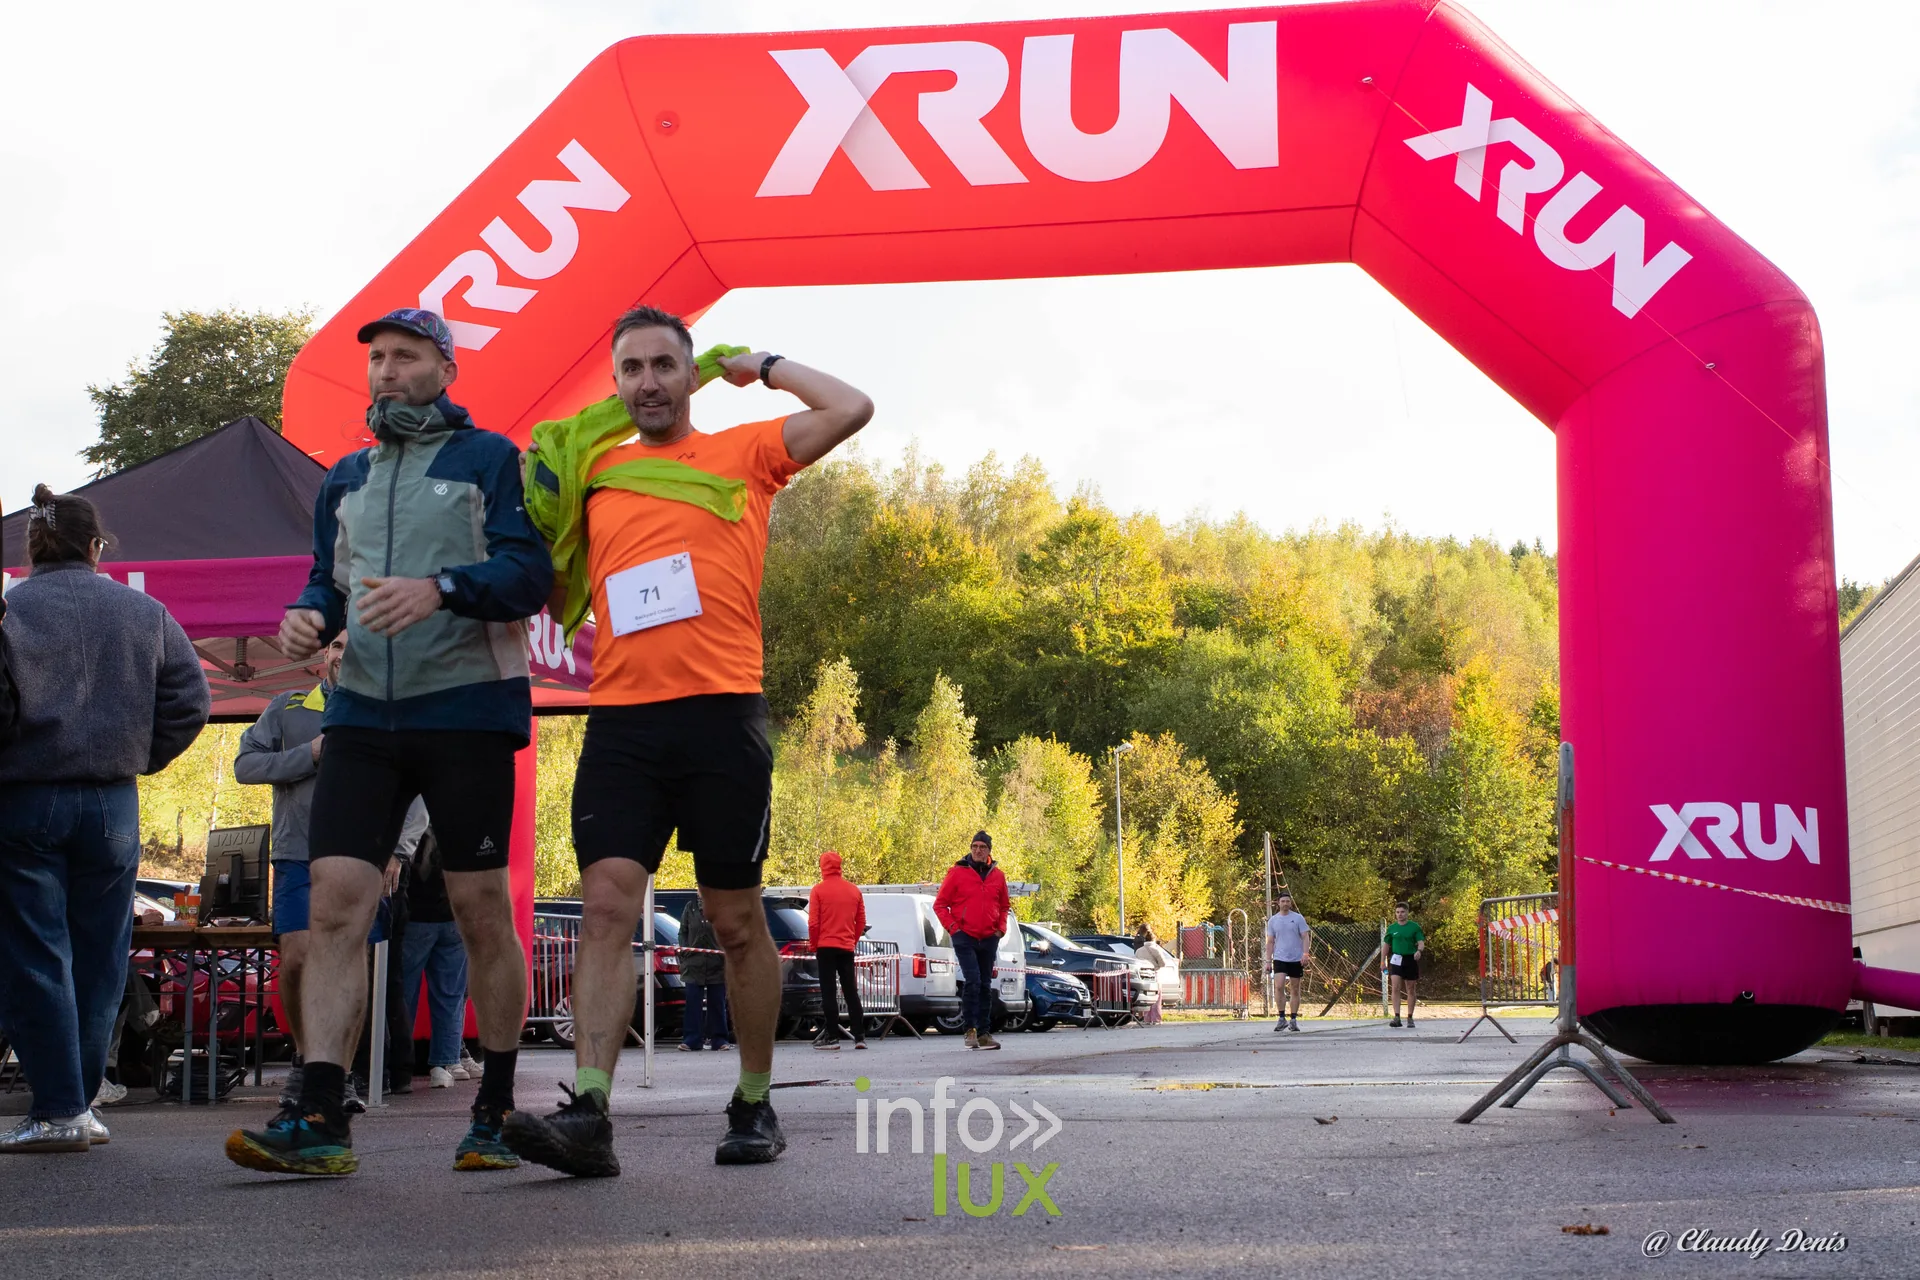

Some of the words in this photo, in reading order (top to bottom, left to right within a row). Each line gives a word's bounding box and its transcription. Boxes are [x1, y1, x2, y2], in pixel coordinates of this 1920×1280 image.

[754, 20, 1280, 198] XRUN
[1402, 81, 1694, 320] XRUN
[639, 586, 660, 604] 71
[1648, 801, 1821, 865] XRUN
